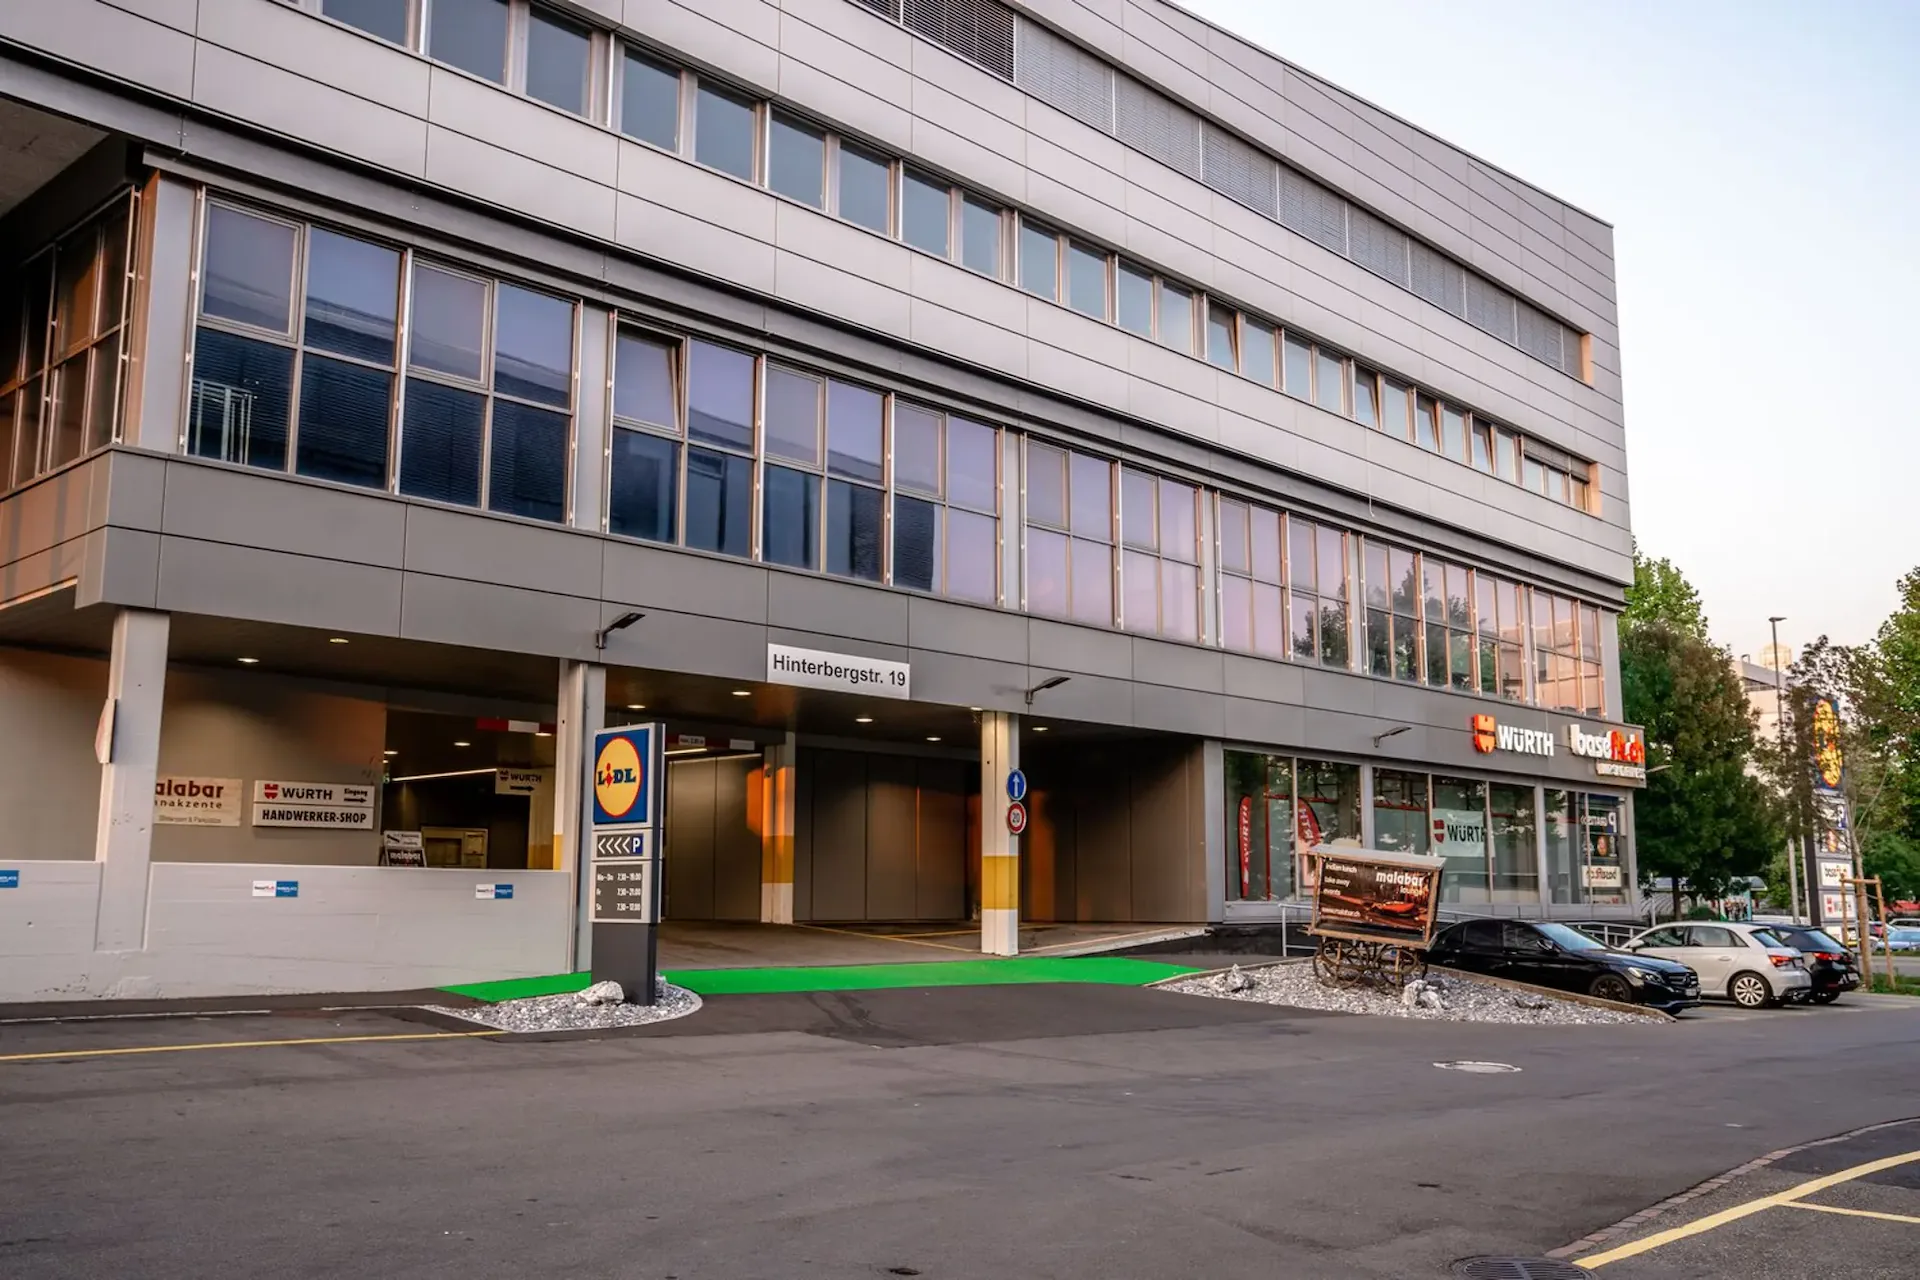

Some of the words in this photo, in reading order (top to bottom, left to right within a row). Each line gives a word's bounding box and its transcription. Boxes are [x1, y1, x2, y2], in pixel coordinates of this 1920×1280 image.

[773, 653, 884, 684] Hinterbergstr.
[889, 670, 906, 687] 19
[155, 779, 224, 799] alabar
[155, 799, 222, 809] nakzente
[262, 809, 367, 823] HANDWERKER-SHOP
[1012, 811, 1021, 824] 20
[632, 837, 641, 853] P
[1375, 871, 1425, 887] malabar
